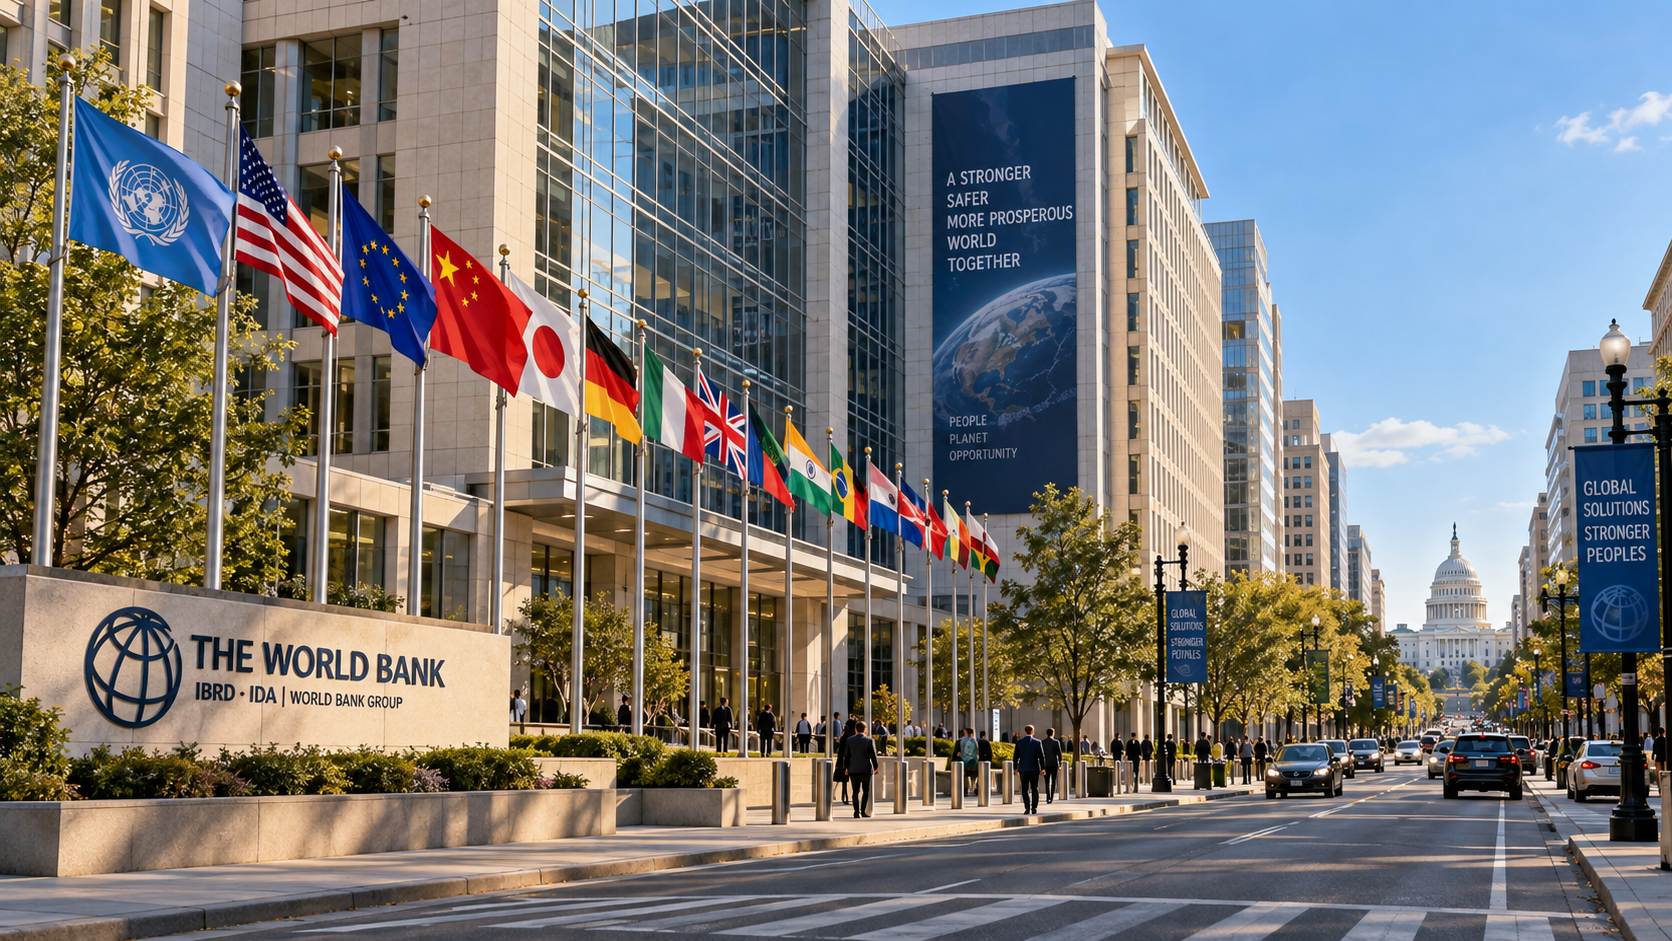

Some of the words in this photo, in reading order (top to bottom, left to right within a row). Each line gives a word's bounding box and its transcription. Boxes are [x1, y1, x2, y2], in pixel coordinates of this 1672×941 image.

[946, 172, 956, 187] A
[960, 165, 1031, 186] STRONGER
[947, 191, 989, 208] SAFER
[947, 212, 985, 230] MORE
[989, 205, 1073, 226] PROSPEROUS
[947, 233, 997, 251] WORLD
[947, 253, 1021, 272] TOGETHER
[949, 415, 987, 428] PEOPLE
[949, 432, 988, 445] PLANET
[949, 448, 1018, 461] OPPORTUNITY
[1583, 479, 1637, 496] GLOBAL
[1583, 500, 1650, 518] SOLUTIONS
[1584, 524, 1651, 541] STRONGER
[1587, 546, 1647, 563] PEOPLES
[1171, 608, 1197, 619] GLOBAL
[1170, 621, 1204, 631] SOLUTIONS
[191, 634, 254, 673] THE
[262, 641, 370, 682] WORLD
[376, 653, 446, 688] BANK
[195, 682, 236, 702] IBRD
[249, 685, 277, 704] IDA
[290, 690, 332, 707] WORLD
[335, 693, 365, 708] BANK
[367, 695, 403, 709] GROUP
